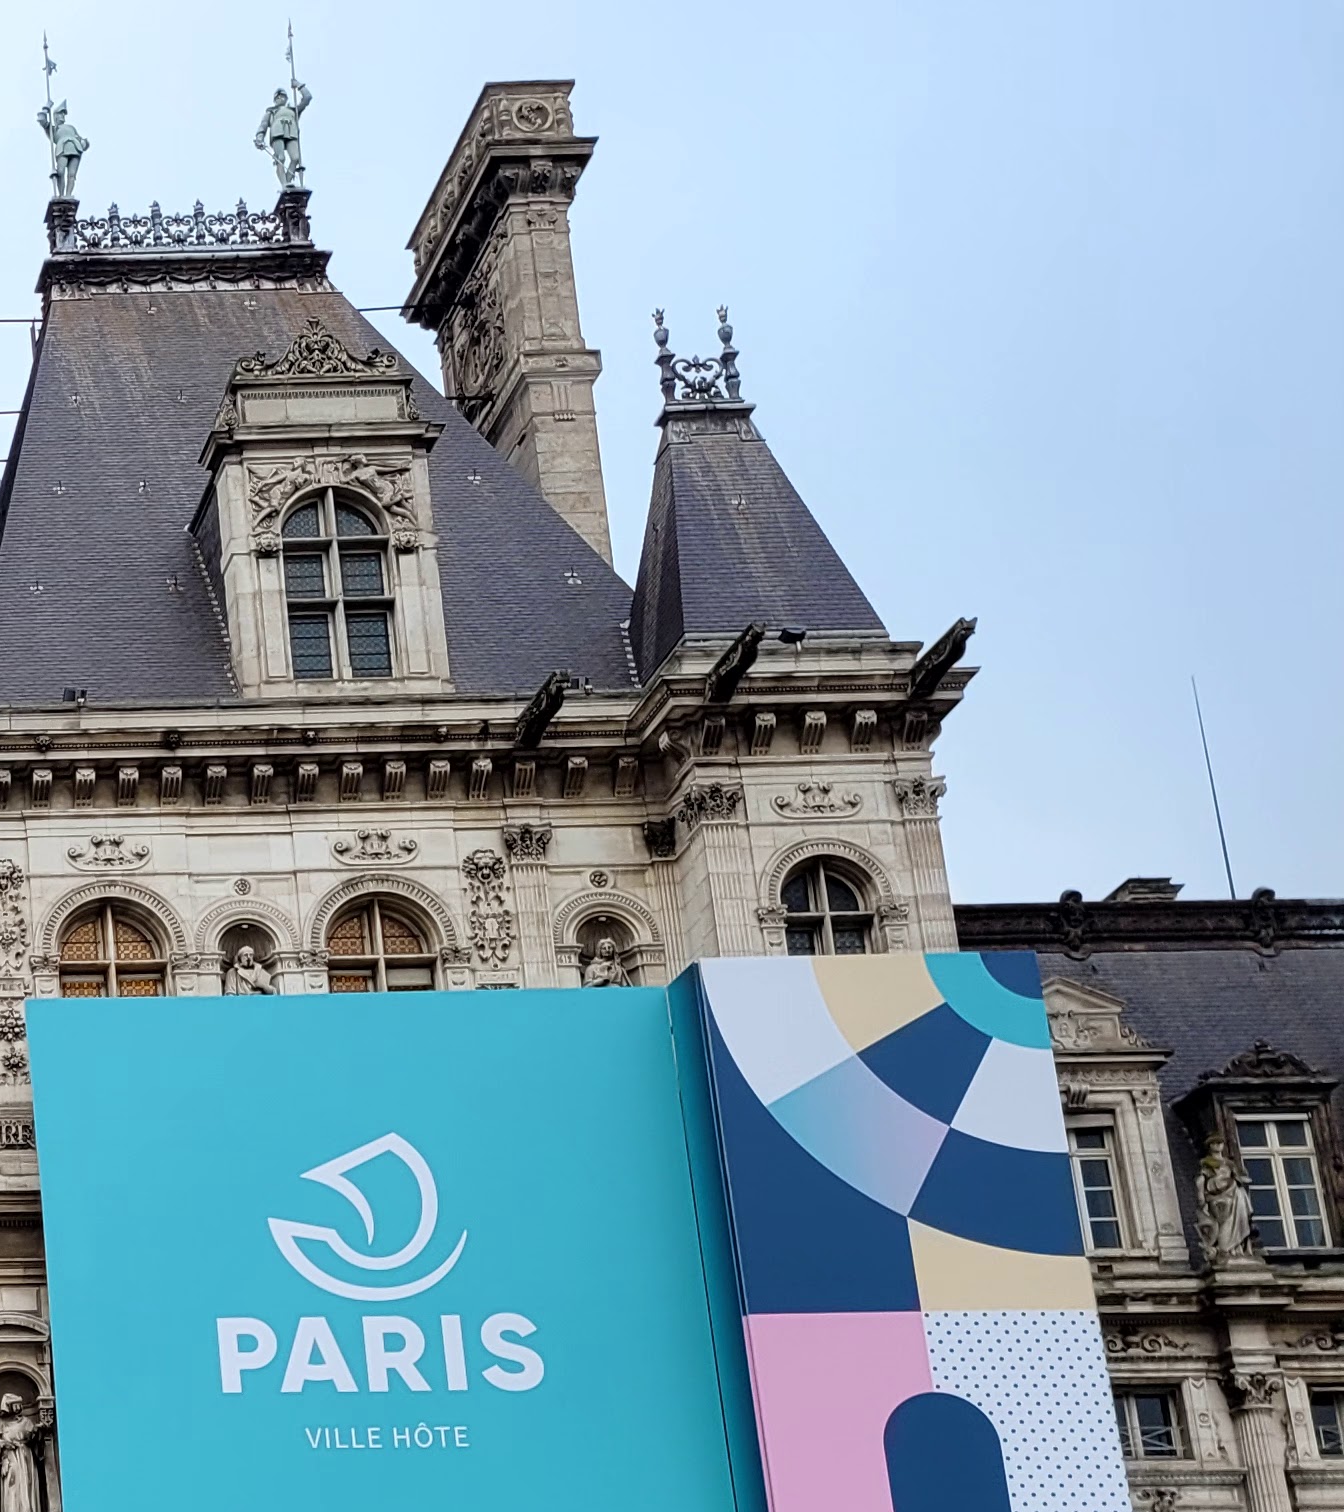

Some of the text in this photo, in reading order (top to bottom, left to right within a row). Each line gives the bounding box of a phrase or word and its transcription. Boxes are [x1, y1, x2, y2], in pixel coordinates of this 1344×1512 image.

[216, 1311, 545, 1394] PARIS
[304, 1422, 471, 1449] VILLE HÔTE
